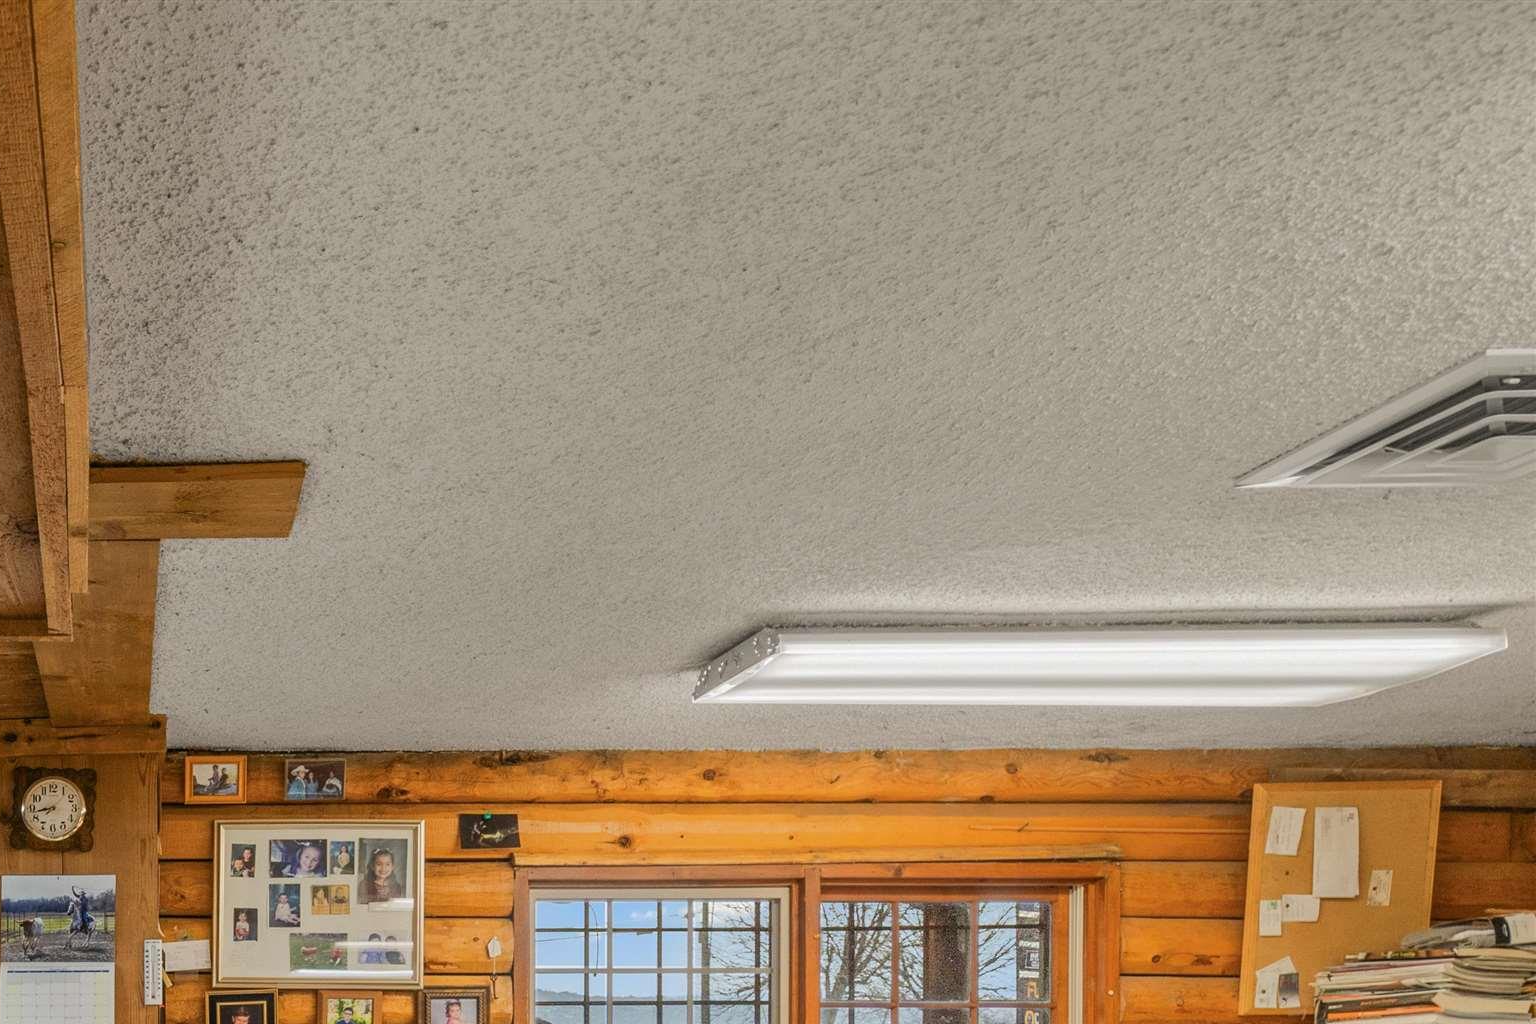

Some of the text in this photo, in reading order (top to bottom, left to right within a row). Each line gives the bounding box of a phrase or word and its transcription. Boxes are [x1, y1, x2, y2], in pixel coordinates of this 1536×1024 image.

[41, 786, 47, 795] 11
[49, 784, 58, 793] 12
[32, 794, 41, 803] 10
[68, 794, 75, 803] 2
[29, 804, 36, 813] 9
[71, 803, 78, 812] 3
[32, 814, 40, 822] 8
[68, 814, 74, 823] 4
[40, 821, 47, 830] 7
[49, 824, 56, 832] 6
[59, 821, 67, 830] 5
